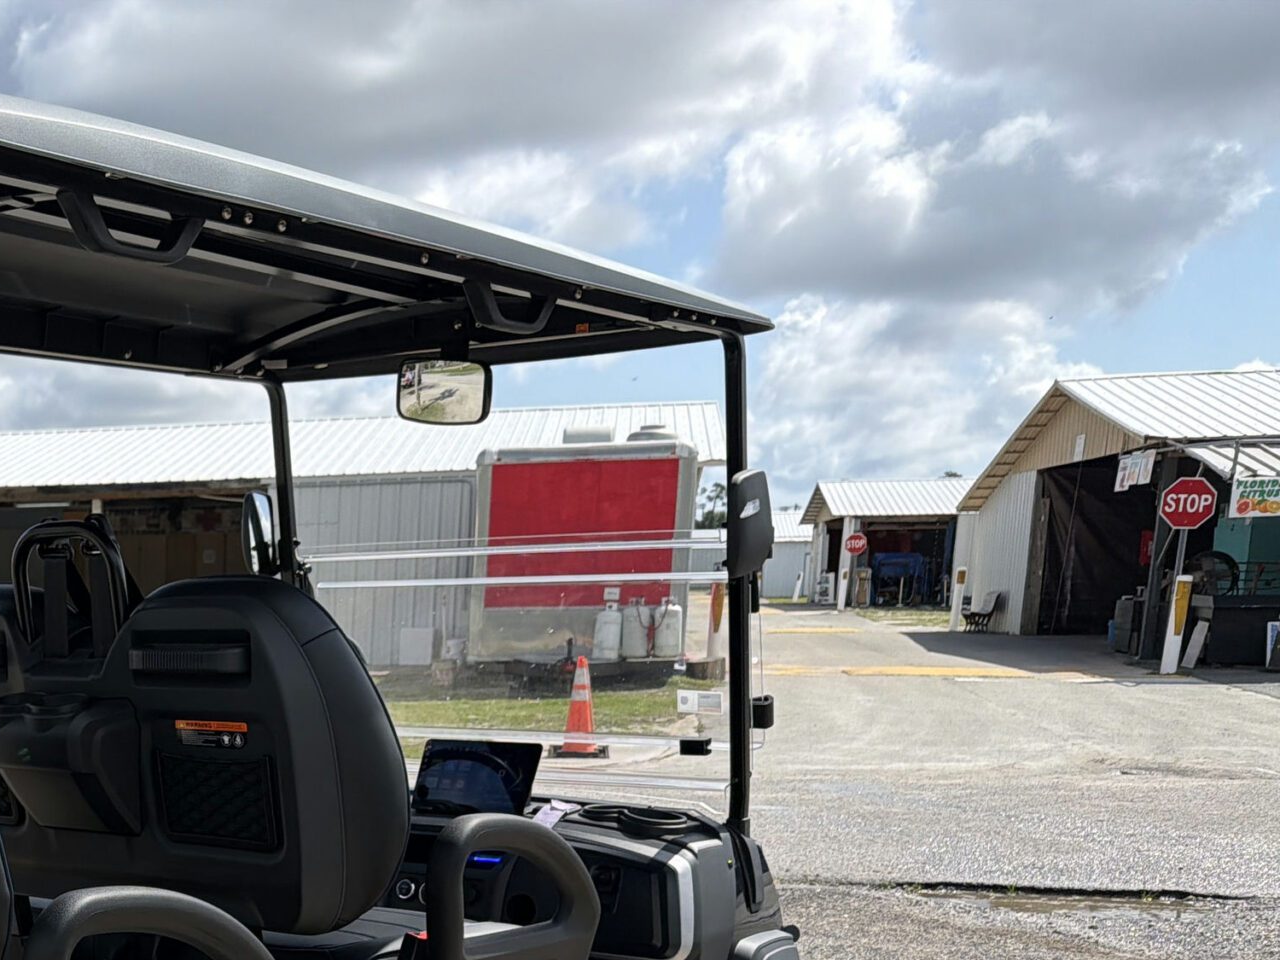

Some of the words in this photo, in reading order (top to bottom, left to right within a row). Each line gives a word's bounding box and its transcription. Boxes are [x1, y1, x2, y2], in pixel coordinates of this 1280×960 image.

[1235, 478, 1280, 490] FLORID
[1164, 493, 1213, 513] STOP
[846, 539, 866, 549] STOP
